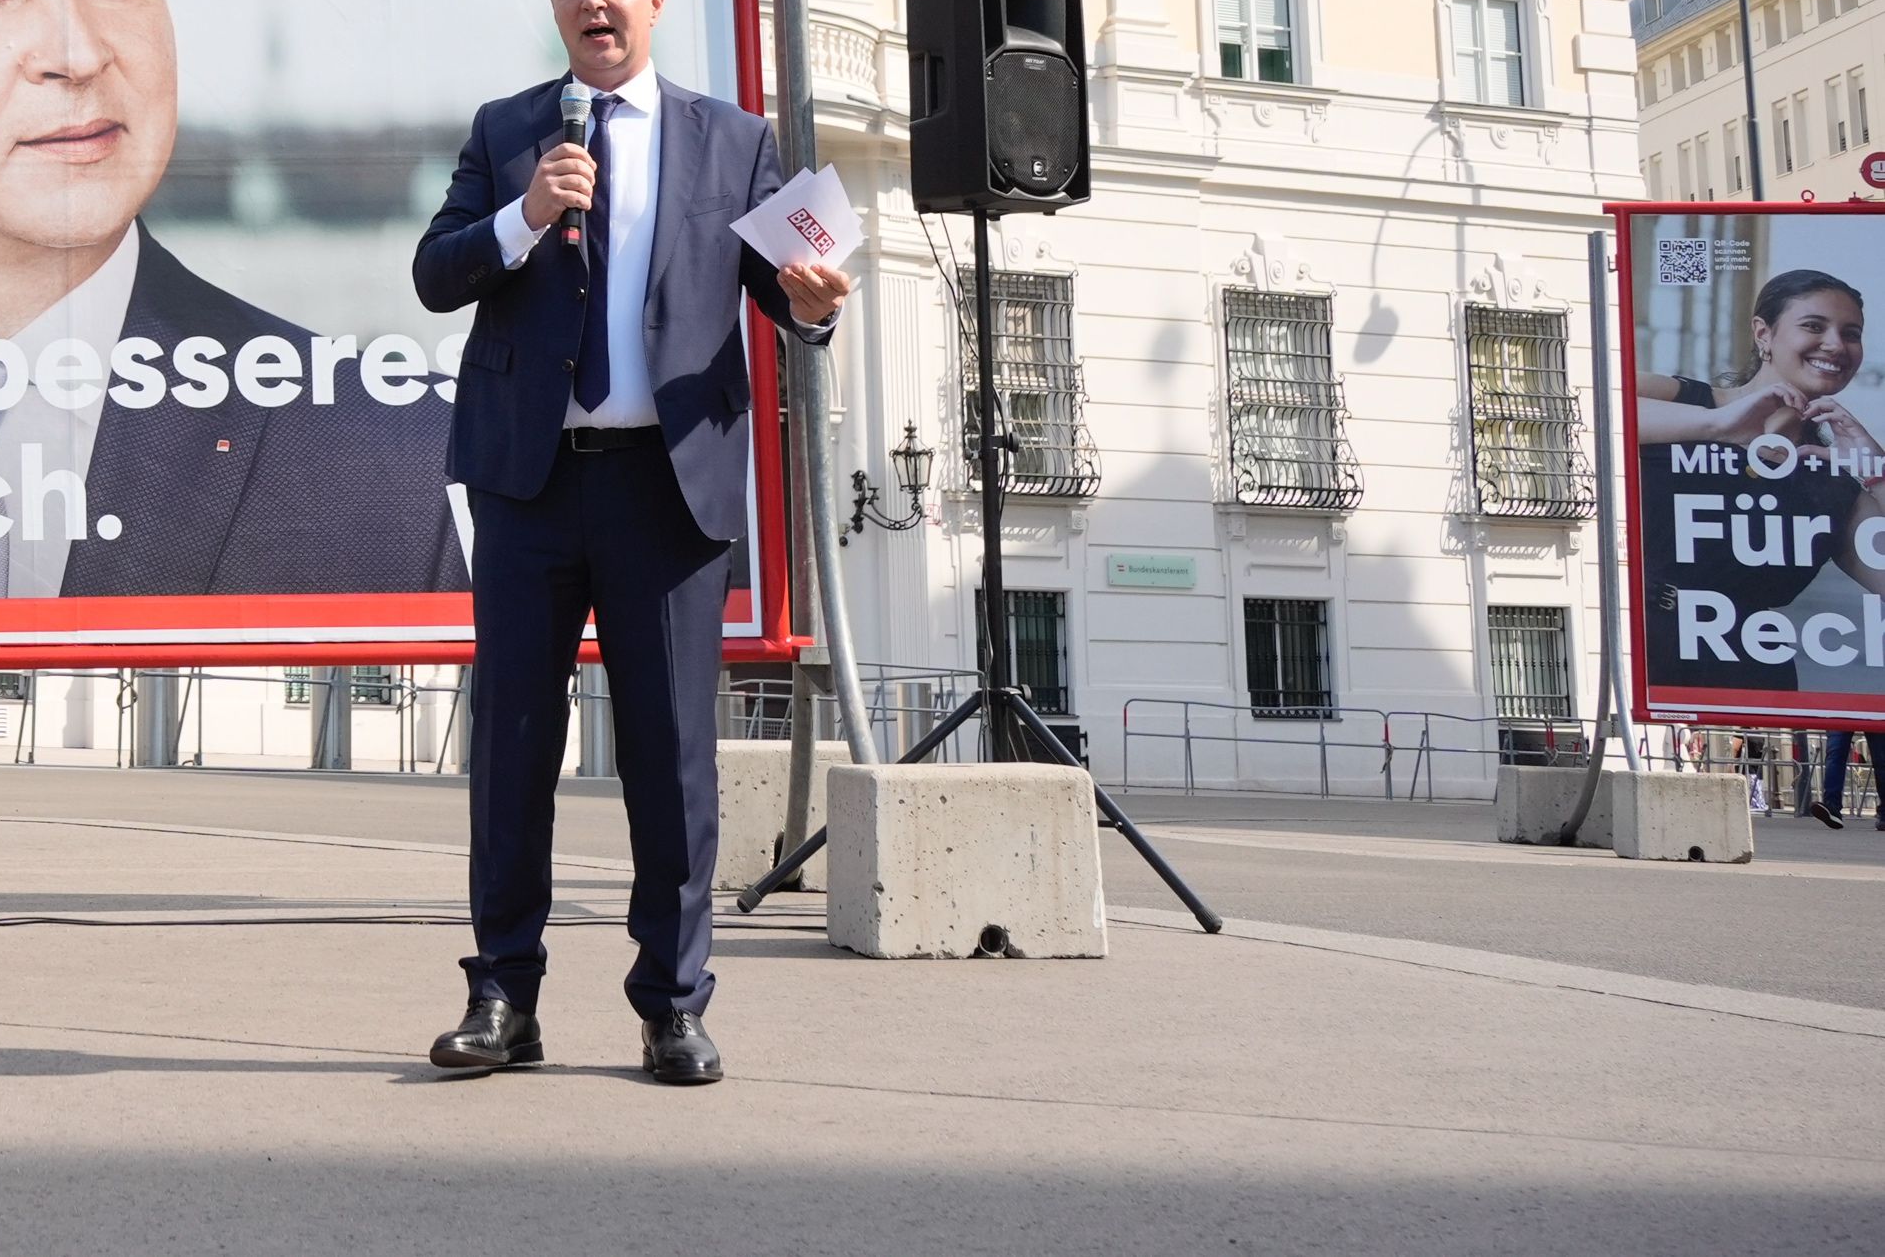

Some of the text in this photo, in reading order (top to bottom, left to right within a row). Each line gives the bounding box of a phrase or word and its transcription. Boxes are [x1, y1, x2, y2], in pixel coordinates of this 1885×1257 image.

[789, 210, 834, 255] BABLER
[1671, 443, 1739, 476] Mit
[1673, 492, 1832, 568] Für
